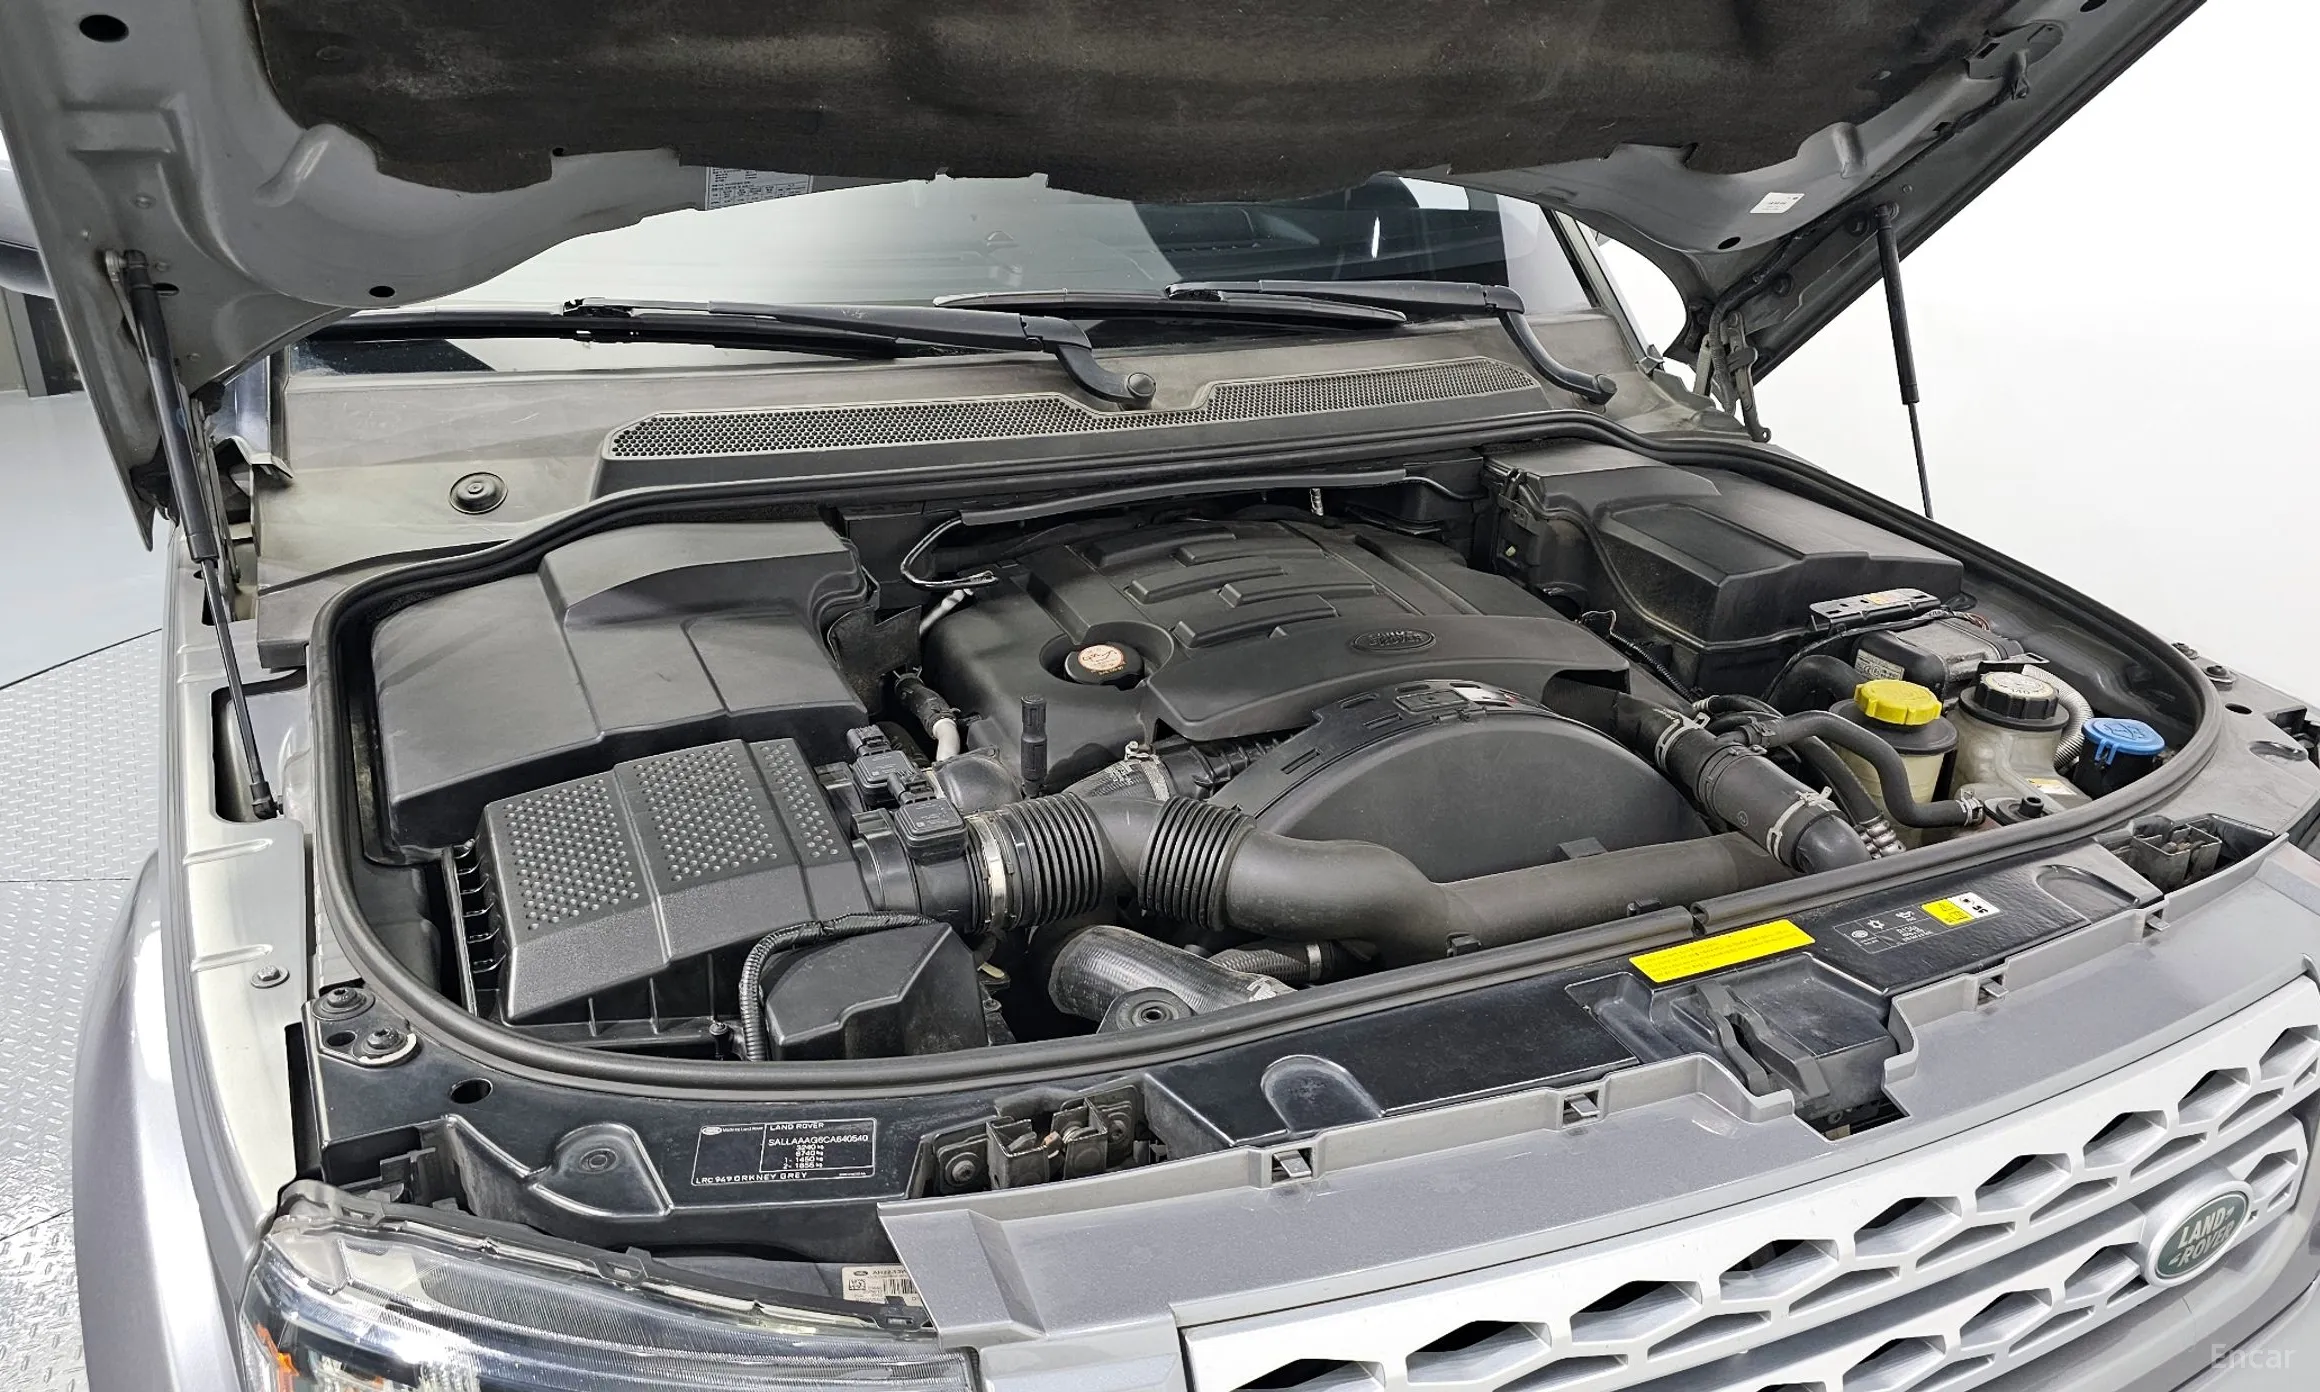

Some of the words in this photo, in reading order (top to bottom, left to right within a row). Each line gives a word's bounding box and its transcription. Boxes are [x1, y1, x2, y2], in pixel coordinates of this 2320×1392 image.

[769, 1123, 794, 1131] LAND
[796, 1122, 825, 1130] ROVER
[715, 1175, 733, 1183] 949
[733, 1173, 776, 1182] ORKNEY
[780, 1171, 808, 1180] GREY
[2177, 1206, 2227, 1250] LAND
[2177, 1220, 2236, 1268] ROVER
